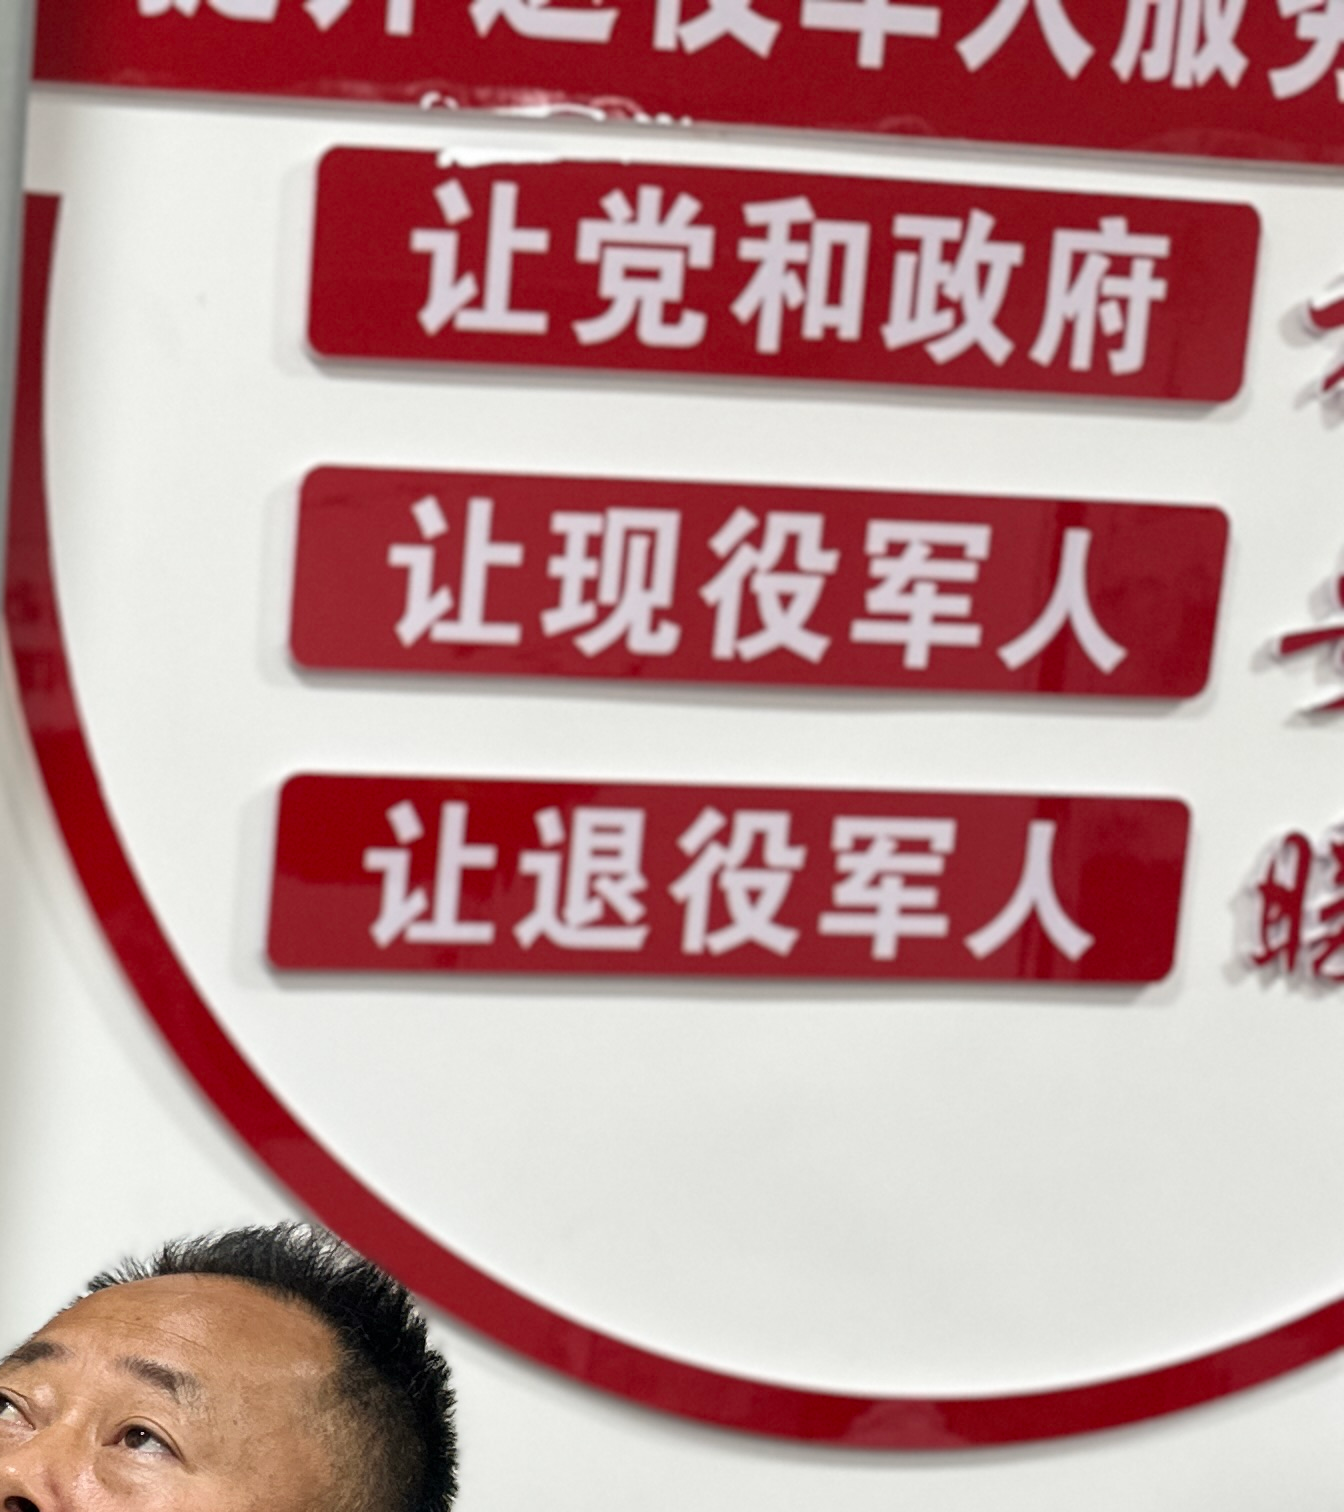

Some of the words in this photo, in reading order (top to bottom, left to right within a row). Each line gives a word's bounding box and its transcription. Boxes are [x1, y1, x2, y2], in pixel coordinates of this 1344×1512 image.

[409, 181, 1170, 374] 让党和政府
[388, 497, 1126, 673] 让现役军人
[363, 802, 1095, 962] 让退役军人
